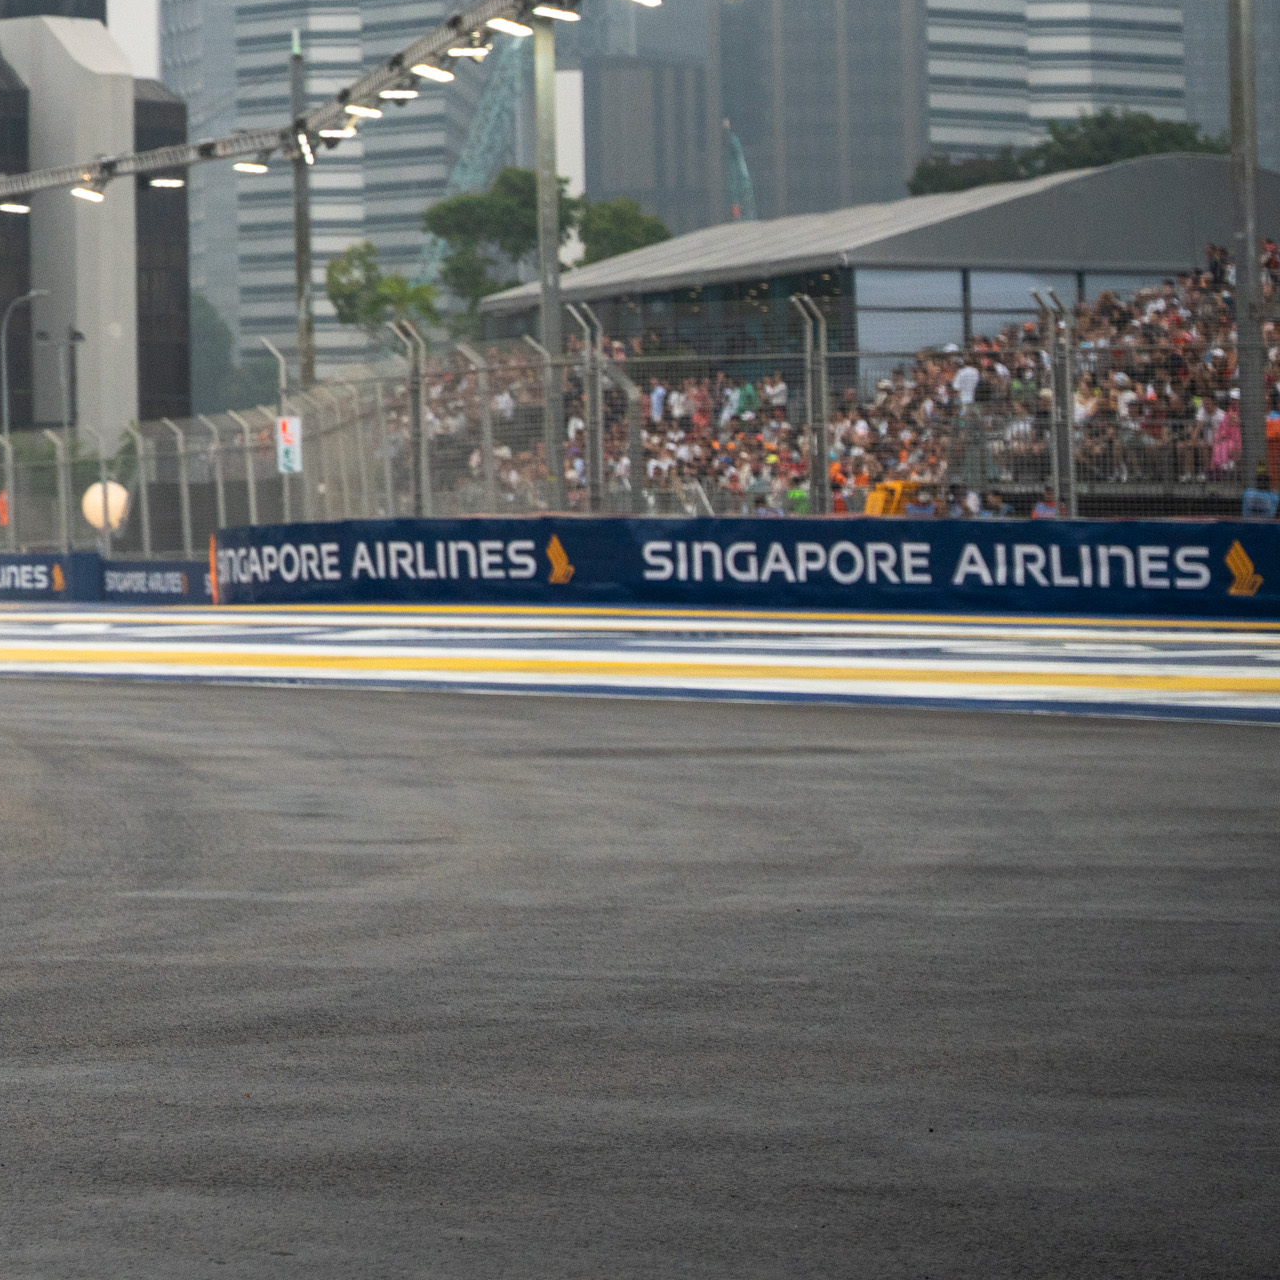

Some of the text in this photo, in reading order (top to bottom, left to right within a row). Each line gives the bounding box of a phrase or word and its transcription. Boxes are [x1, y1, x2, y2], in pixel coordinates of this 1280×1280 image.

[351, 540, 537, 580] AIRLINES
[643, 541, 1212, 590] SINGAPORE AIRLINES
